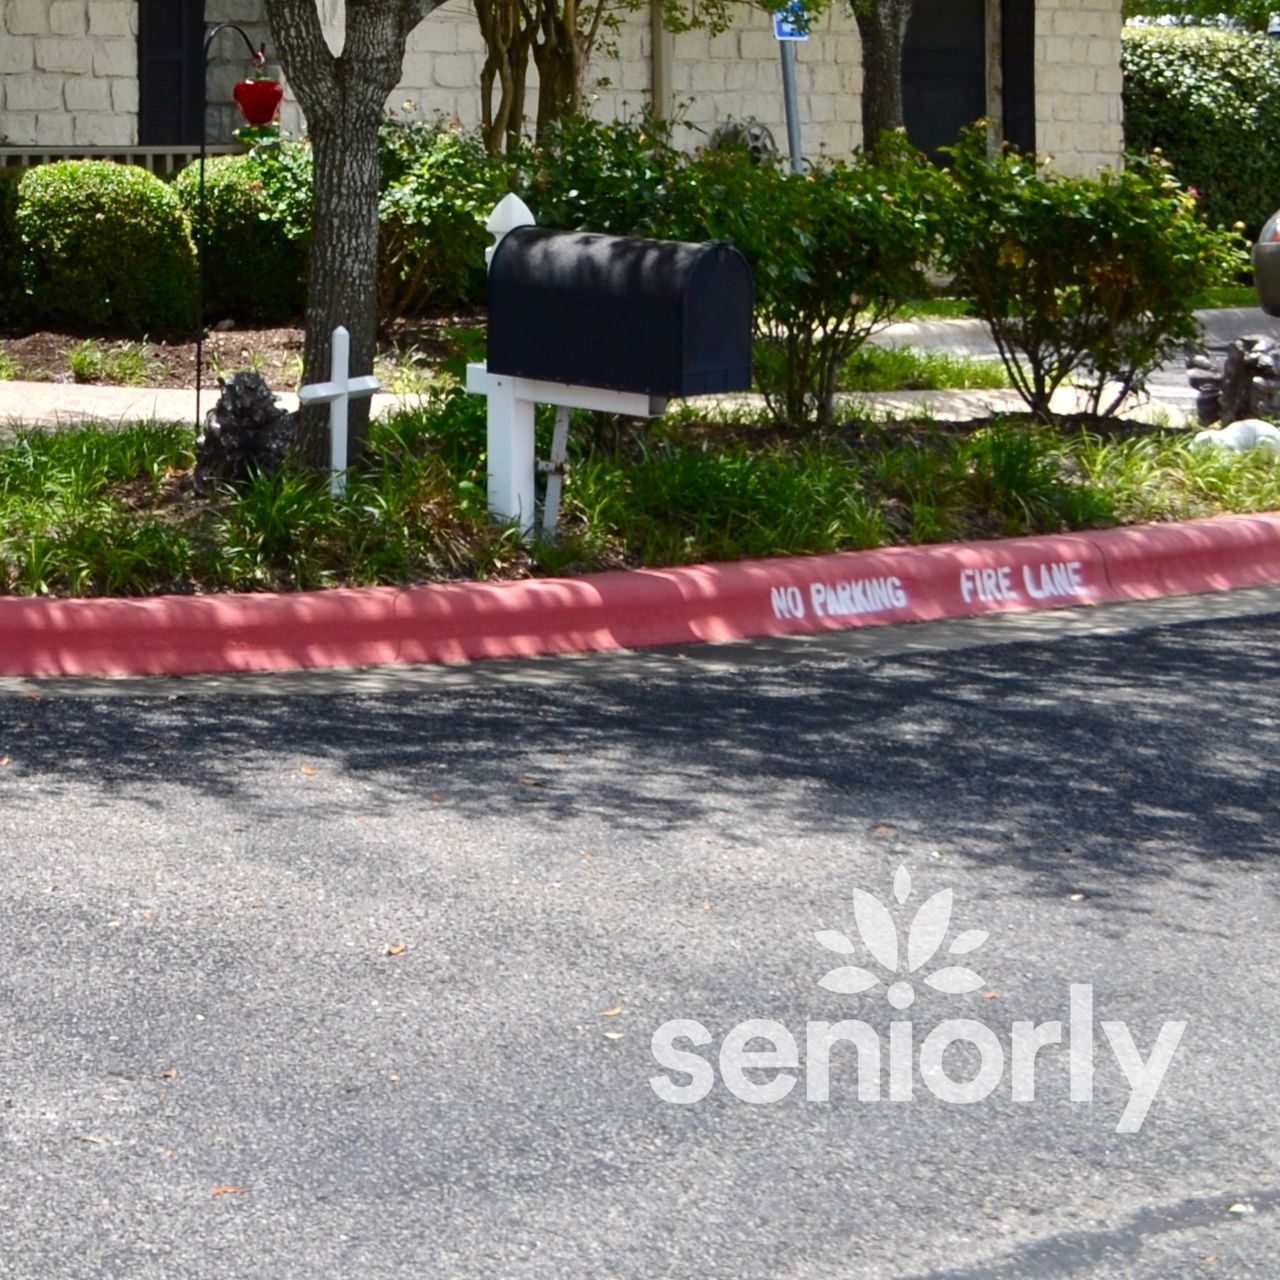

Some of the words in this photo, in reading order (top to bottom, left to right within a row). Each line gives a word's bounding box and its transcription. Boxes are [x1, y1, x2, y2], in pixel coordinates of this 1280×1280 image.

[771, 586, 804, 619] NO
[811, 577, 907, 616] PARKING
[959, 566, 1019, 604] FIRE
[1023, 561, 1092, 600] LANE
